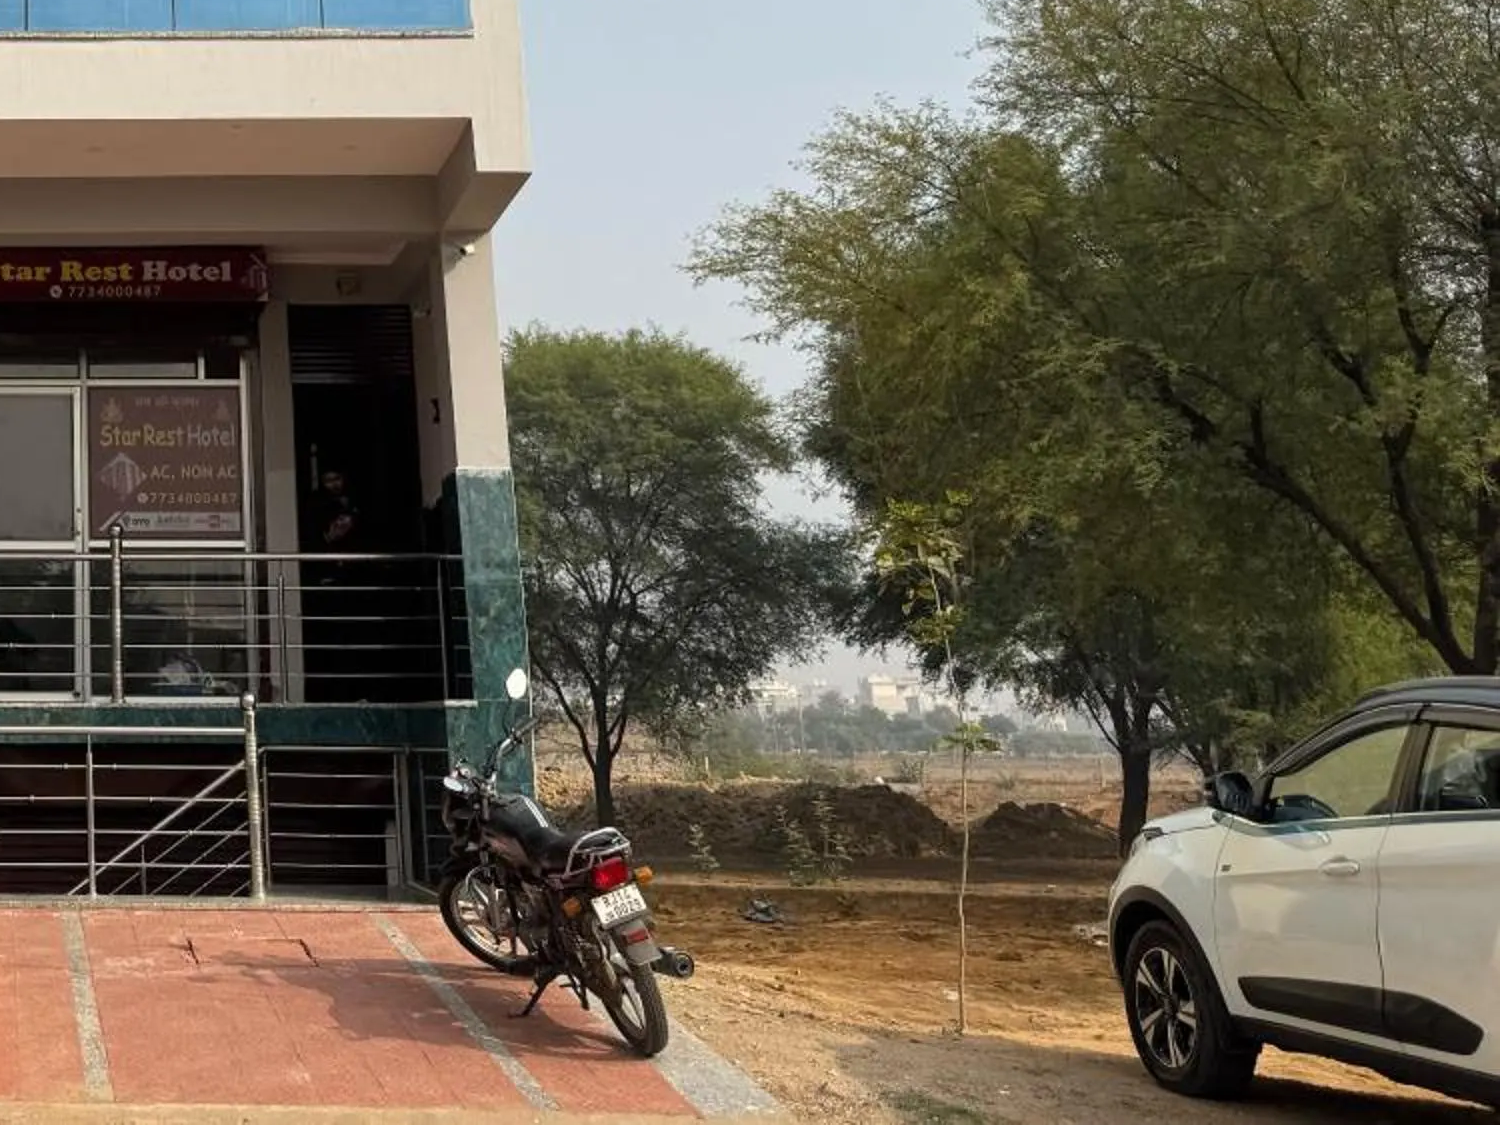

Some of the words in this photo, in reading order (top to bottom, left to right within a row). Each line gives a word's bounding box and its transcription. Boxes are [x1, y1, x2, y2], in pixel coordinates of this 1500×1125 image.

[60, 260, 134, 283] Rest
[141, 260, 232, 283] Hotel
[100, 425, 141, 446] Star
[143, 423, 185, 446] Rest
[187, 424, 237, 446] Hotel
[182, 465, 213, 479] NON
[216, 464, 238, 479] AC
